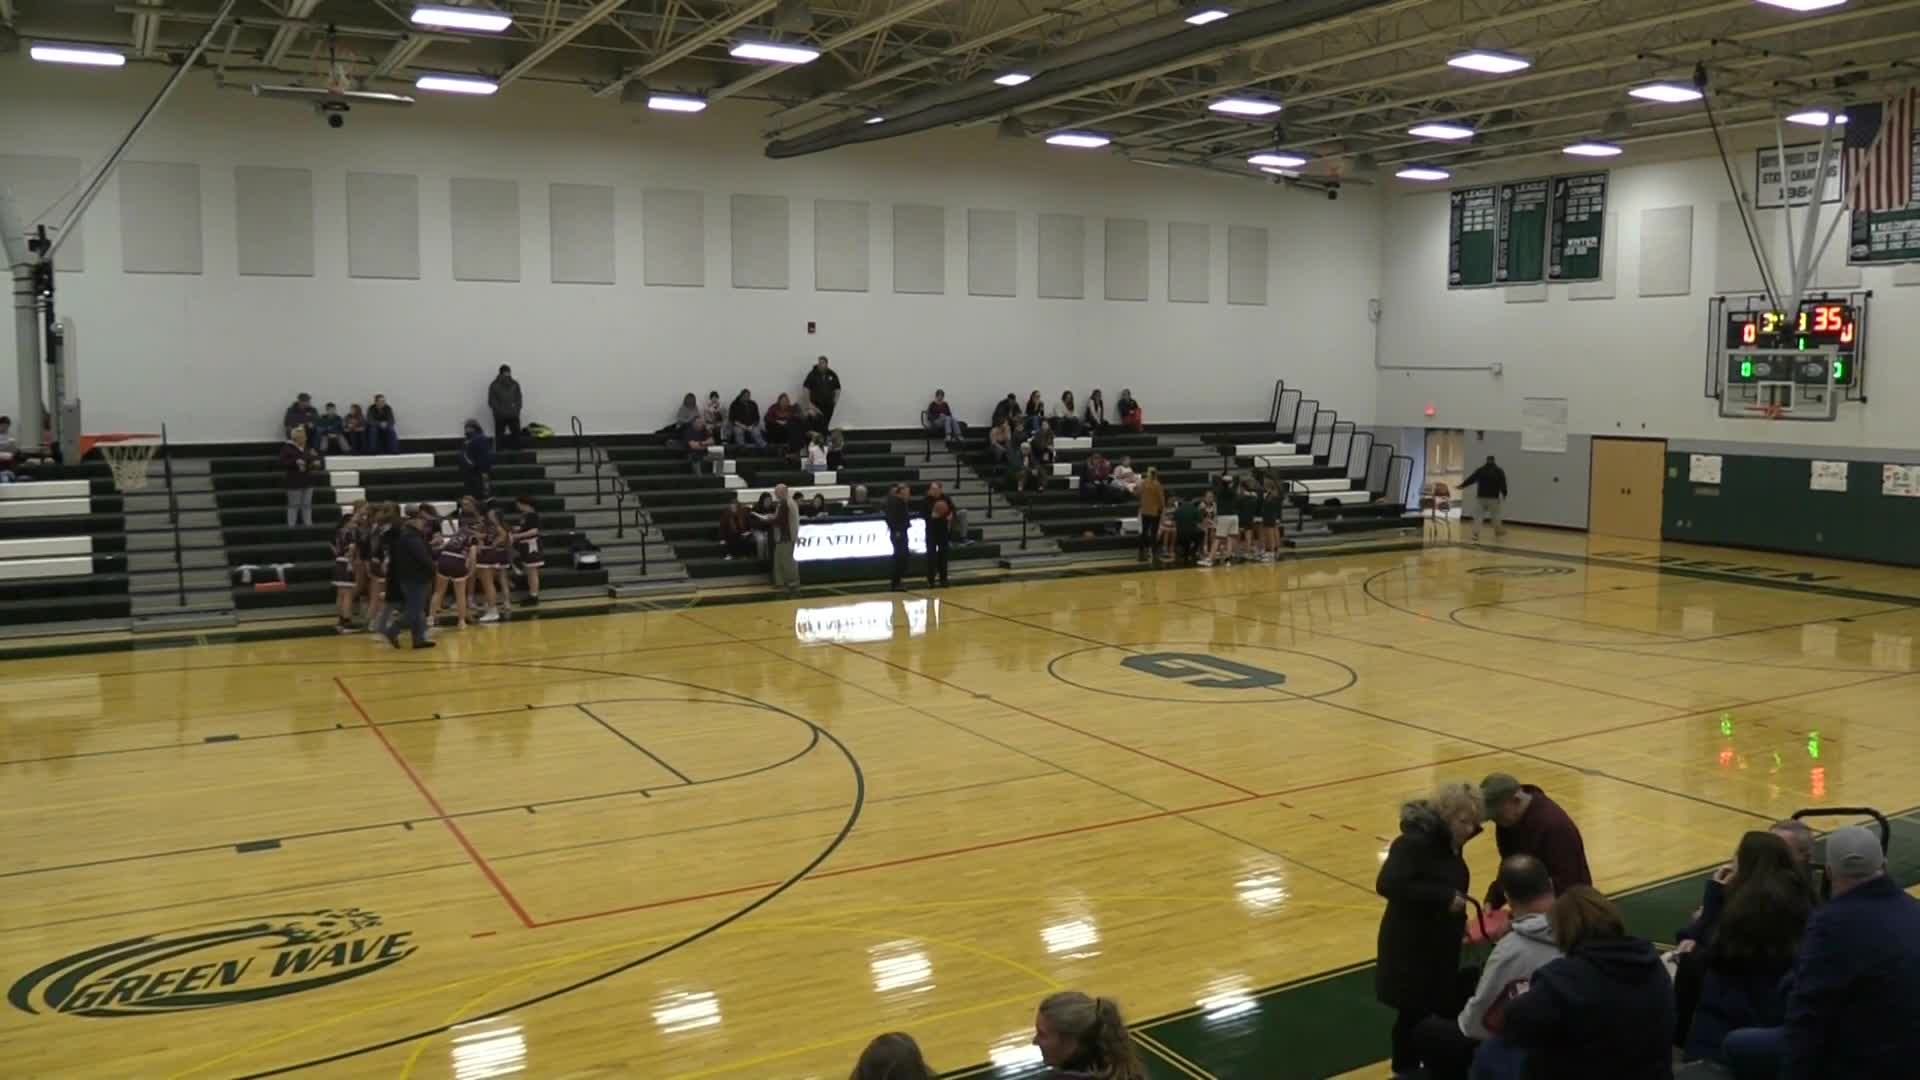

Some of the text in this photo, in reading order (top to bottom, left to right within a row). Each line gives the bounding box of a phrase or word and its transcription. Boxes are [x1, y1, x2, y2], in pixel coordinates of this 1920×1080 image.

[1814, 307, 1842, 331] 35
[1743, 324, 1756, 343] 0
[1741, 362, 1752, 377] 0
[797, 533, 877, 548] REENFIELD
[1590, 551, 1841, 582] GREEN
[59, 931, 414, 1014] GREEN WAVE
